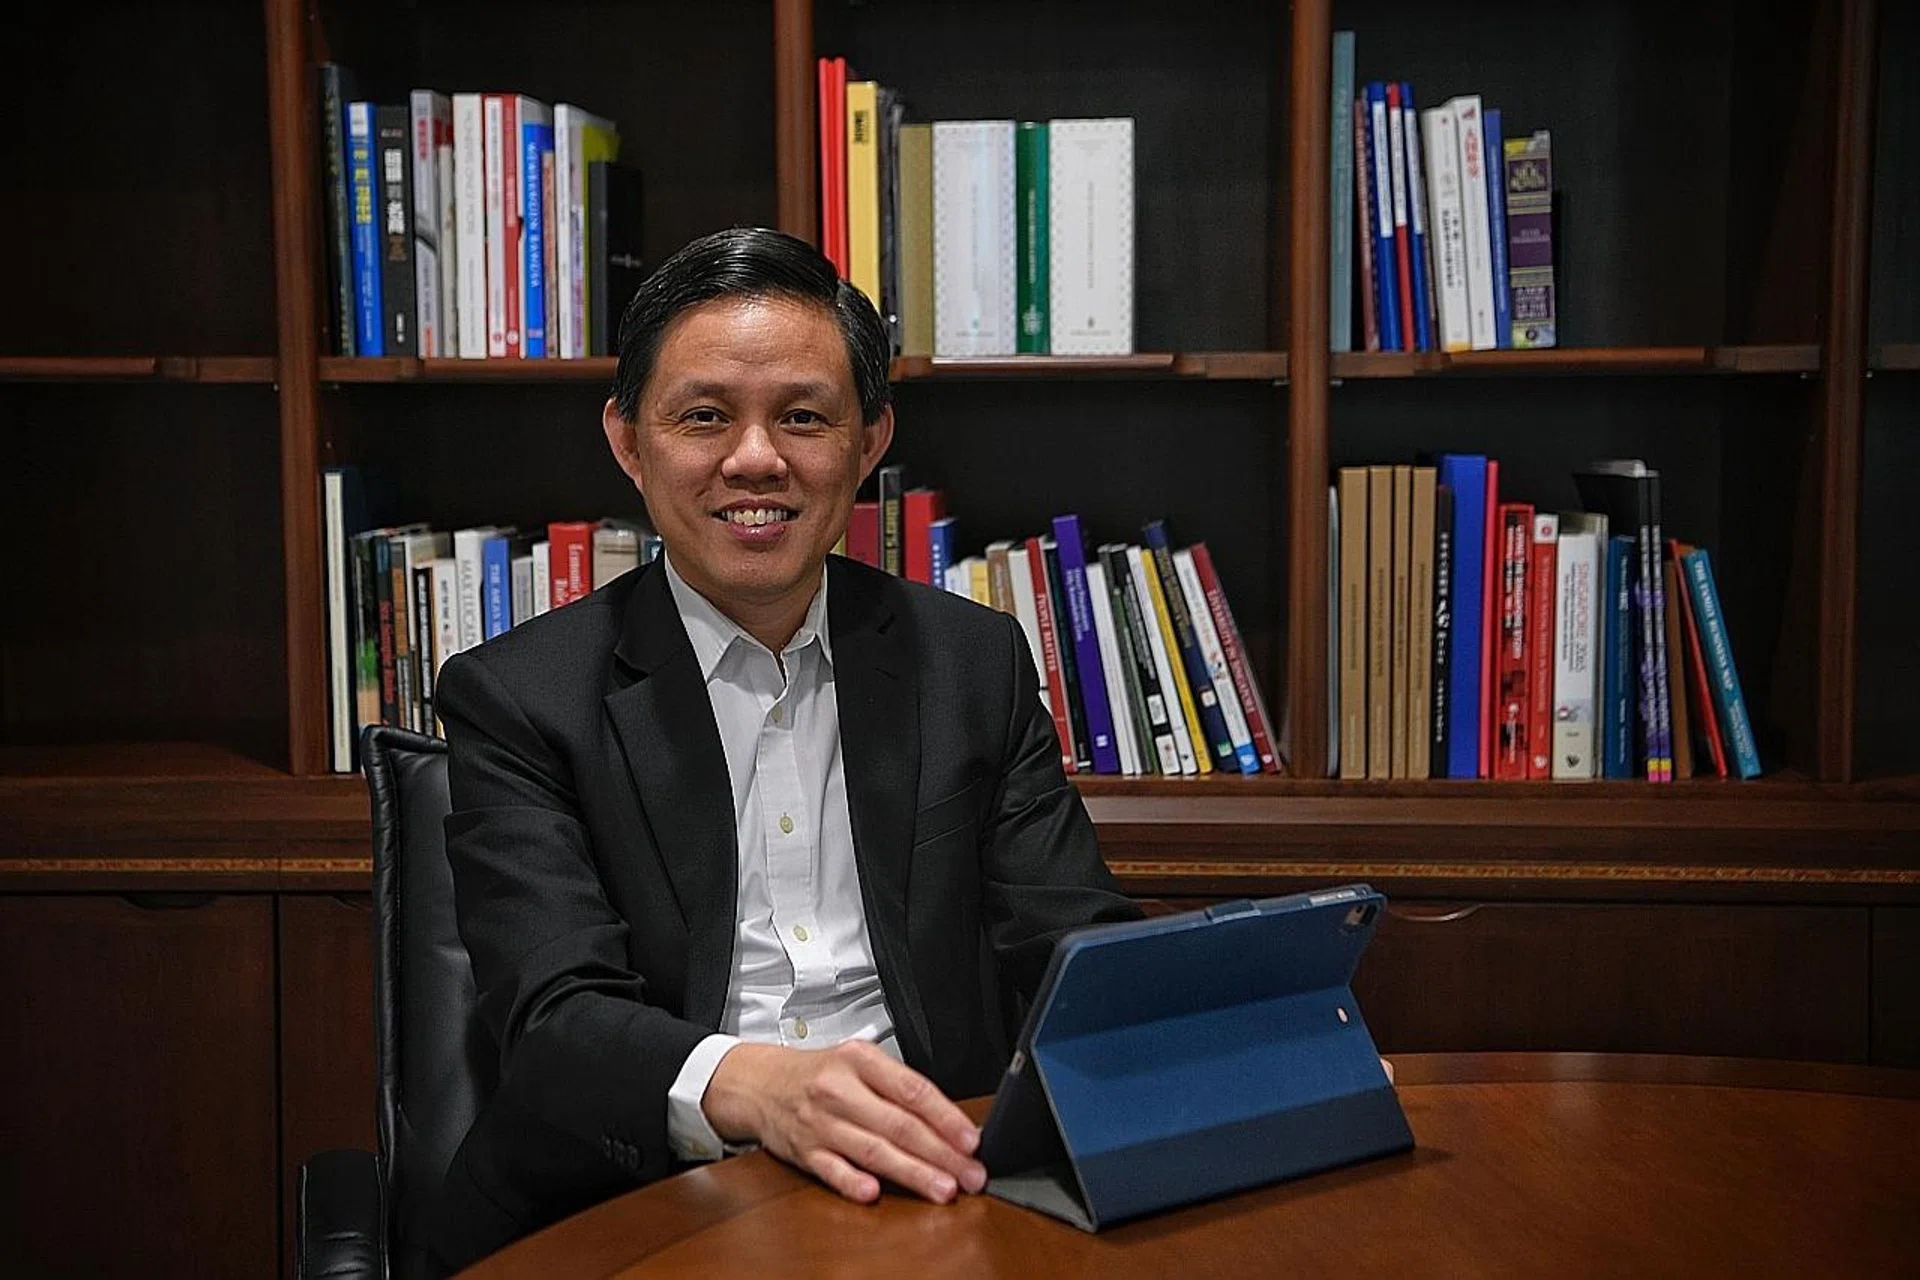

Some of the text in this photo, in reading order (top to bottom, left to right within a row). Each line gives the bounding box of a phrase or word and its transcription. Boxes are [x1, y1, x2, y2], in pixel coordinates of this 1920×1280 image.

[1037, 593, 1056, 672] PEOPLE MATTER
[1576, 562, 1589, 639] SINGAPORE
[1694, 560, 1734, 691] THE FAMILY BUSINESS MAP
